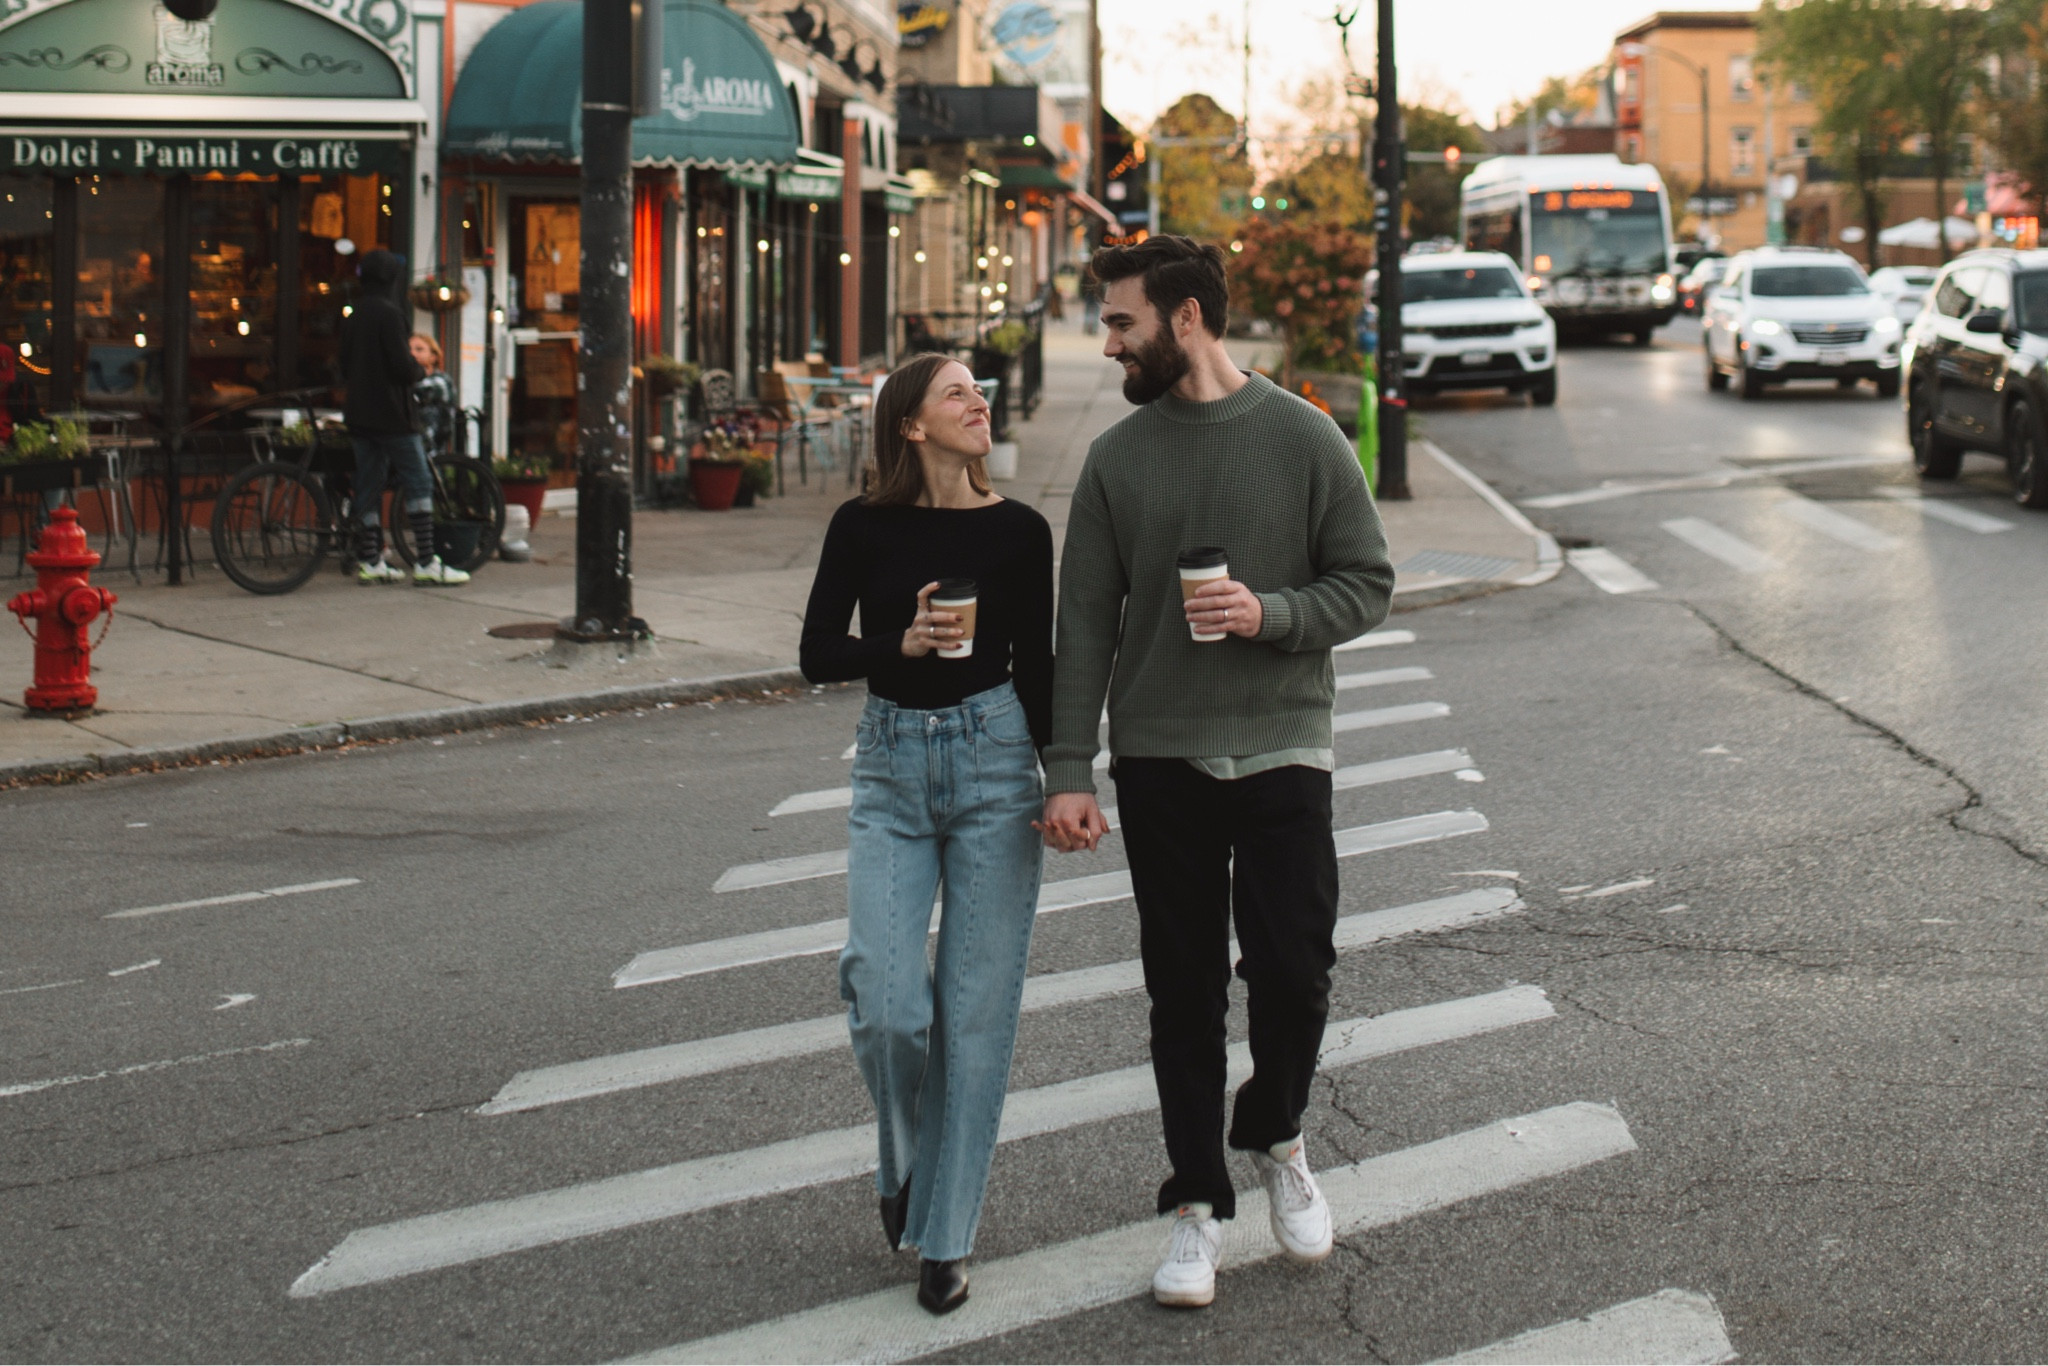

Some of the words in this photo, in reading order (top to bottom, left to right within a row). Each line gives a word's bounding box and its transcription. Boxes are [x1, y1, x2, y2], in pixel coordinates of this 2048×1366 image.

[148, 64, 222, 86] aroma
[702, 76, 774, 110] AROMA
[13, 138, 99, 167] Dolci
[135, 139, 239, 167] Panini
